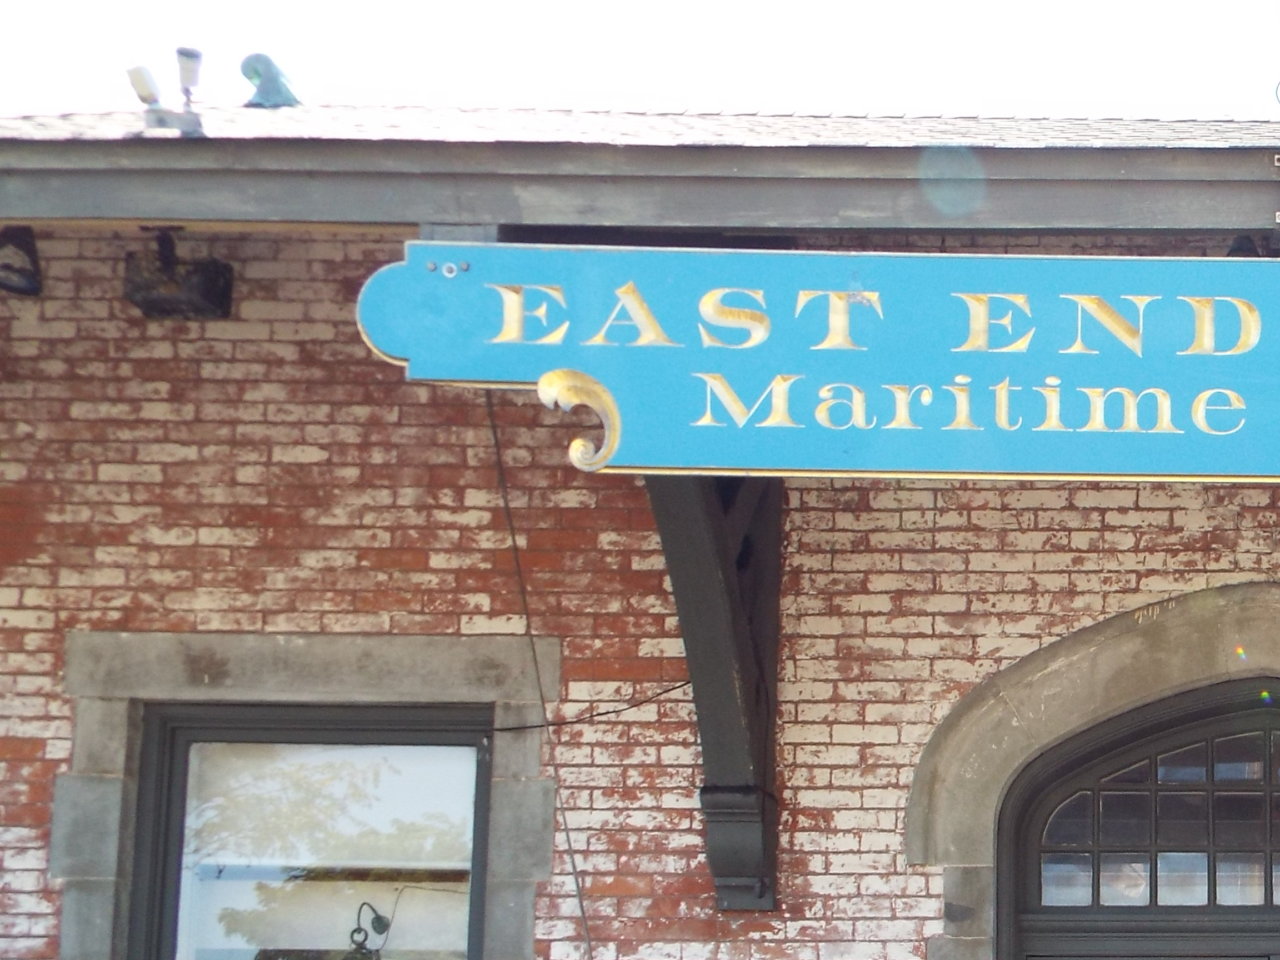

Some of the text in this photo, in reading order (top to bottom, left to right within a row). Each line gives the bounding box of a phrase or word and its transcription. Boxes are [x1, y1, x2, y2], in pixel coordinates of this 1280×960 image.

[483, 281, 885, 352] EAST
[951, 292, 1263, 359] END
[690, 371, 1248, 437] Maritime
